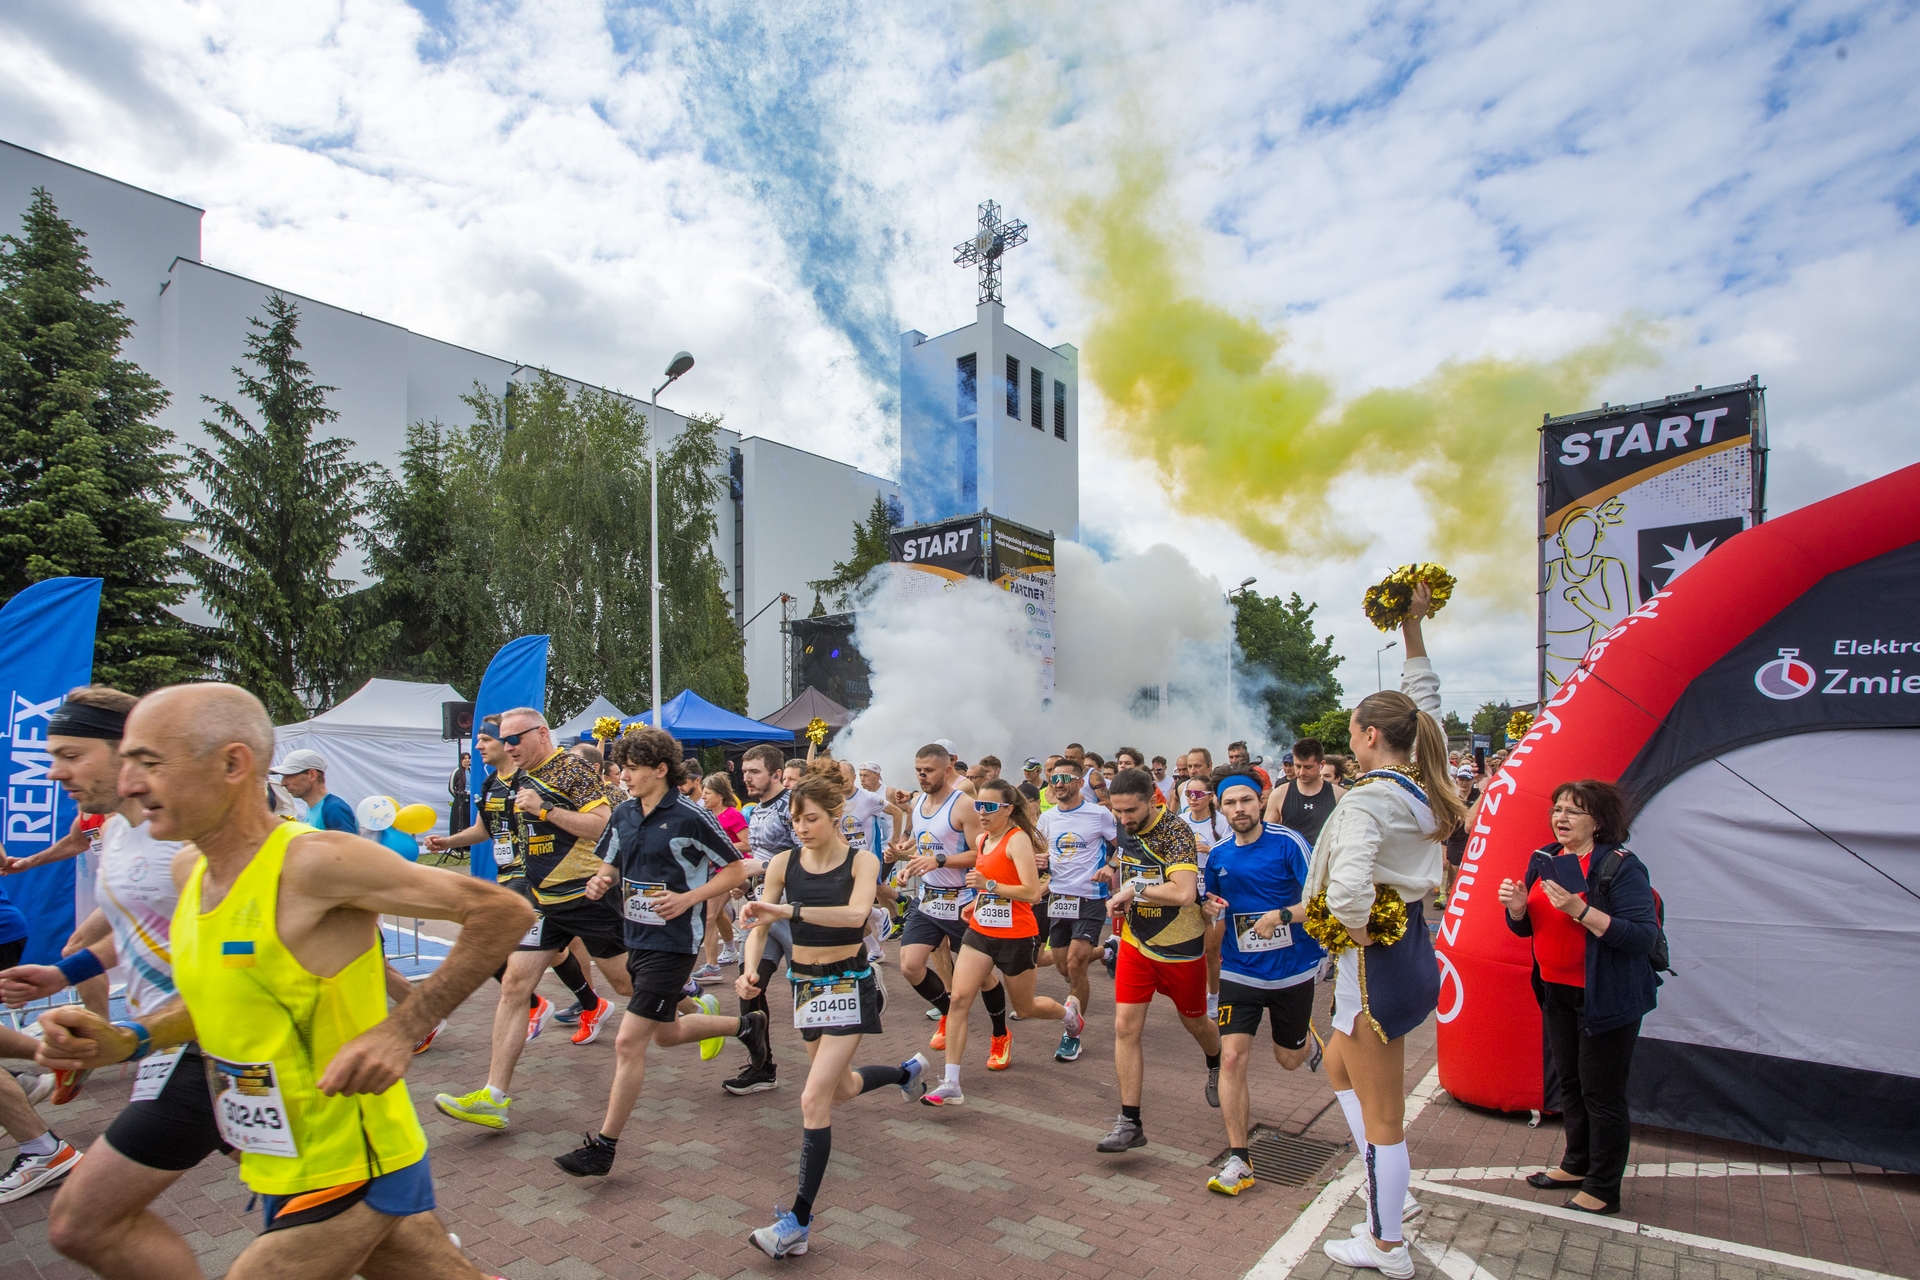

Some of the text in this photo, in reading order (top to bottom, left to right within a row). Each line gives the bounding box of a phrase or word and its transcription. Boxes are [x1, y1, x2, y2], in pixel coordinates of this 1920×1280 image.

[1558, 407, 1729, 466] START
[902, 527, 974, 562] START
[1030, 573, 1048, 586] biegu
[1010, 581, 1045, 600] PARTNER
[1821, 668, 1920, 694] Zmie
[7, 694, 62, 842] REMEX
[629, 899, 655, 913] 3042
[931, 901, 956, 912] 30178
[981, 907, 1010, 919] 30386
[1054, 902, 1078, 911] 30379
[810, 998, 857, 1013] 30406
[1217, 1004, 1233, 1027] 27
[222, 1096, 284, 1130] 30243
